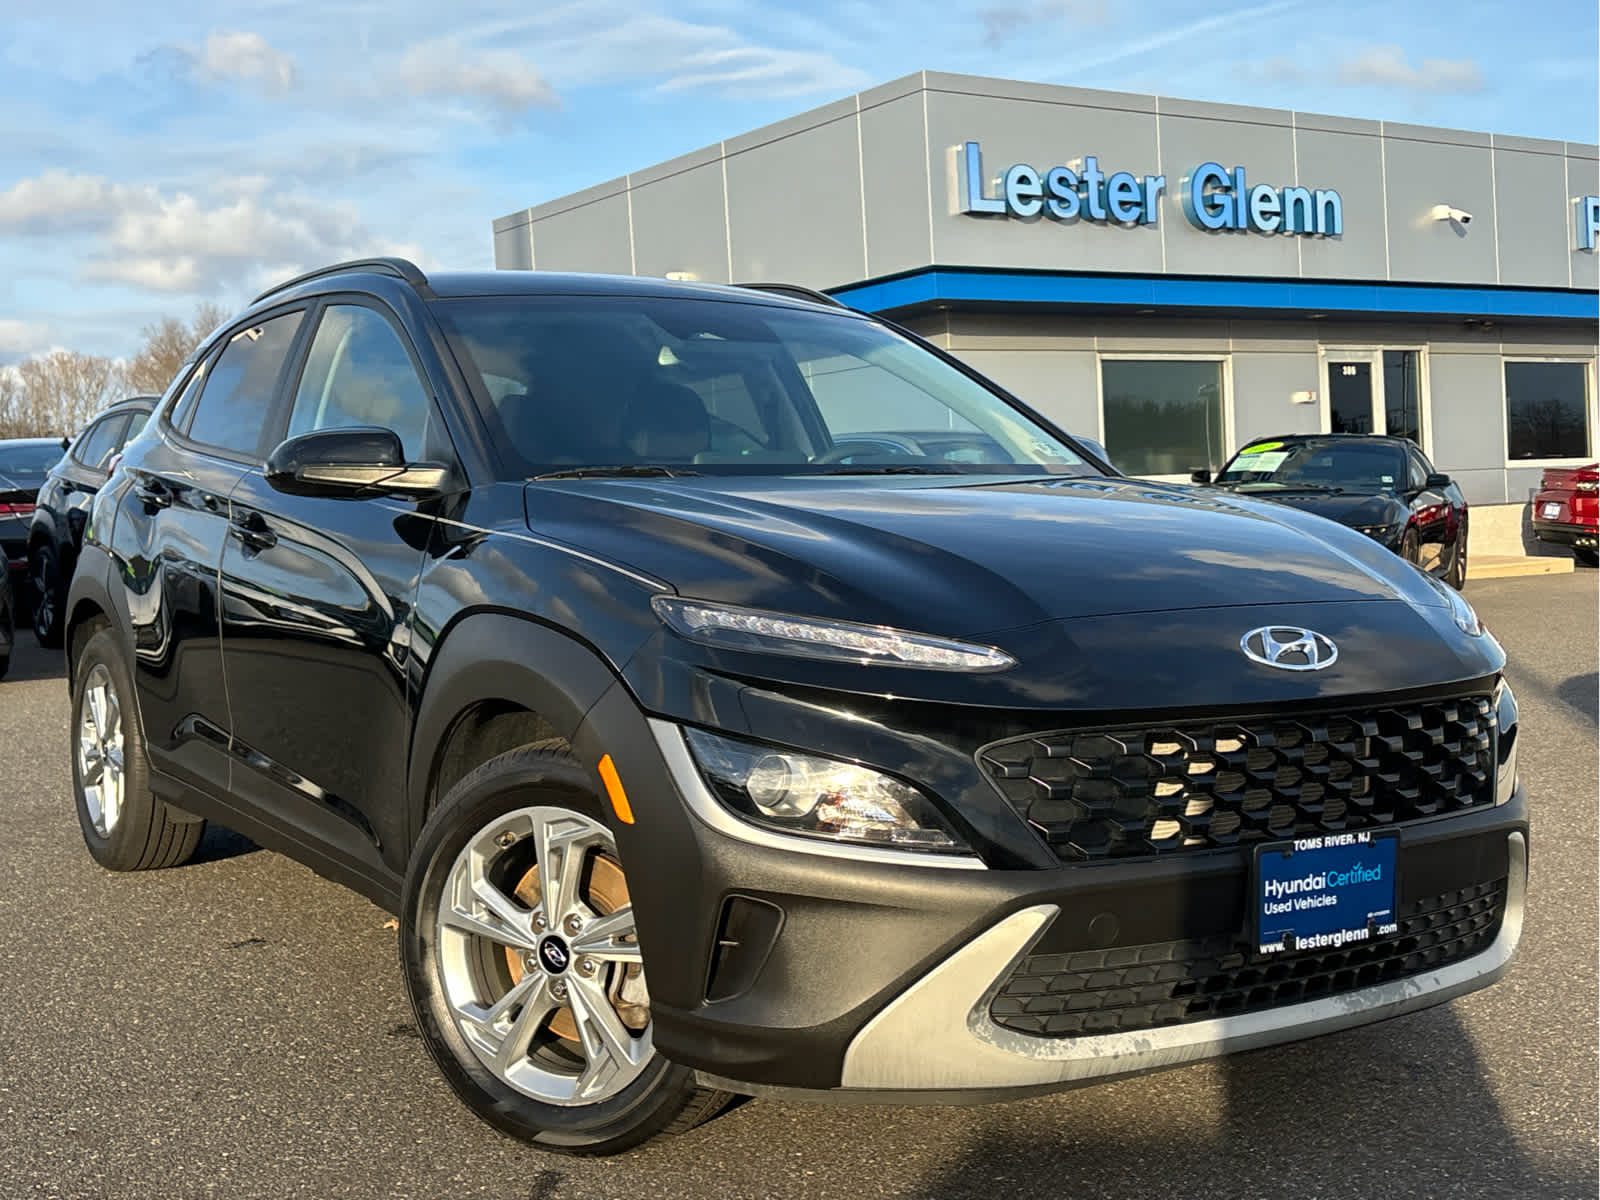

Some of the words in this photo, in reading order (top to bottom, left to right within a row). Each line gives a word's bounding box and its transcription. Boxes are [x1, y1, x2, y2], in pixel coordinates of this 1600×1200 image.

[963, 141, 1167, 224] Lester
[1190, 161, 1344, 236] Glenn
[1293, 837, 1322, 851] TOMS
[1358, 832, 1371, 843] NJ
[1265, 872, 1326, 899] Hyundai
[1327, 862, 1381, 888] Certified
[1264, 900, 1292, 915] Used
[1294, 894, 1337, 910] Vehicles
[1259, 941, 1286, 954] www.
[1295, 928, 1369, 950] lesterglenn
[1376, 923, 1398, 935] .com
